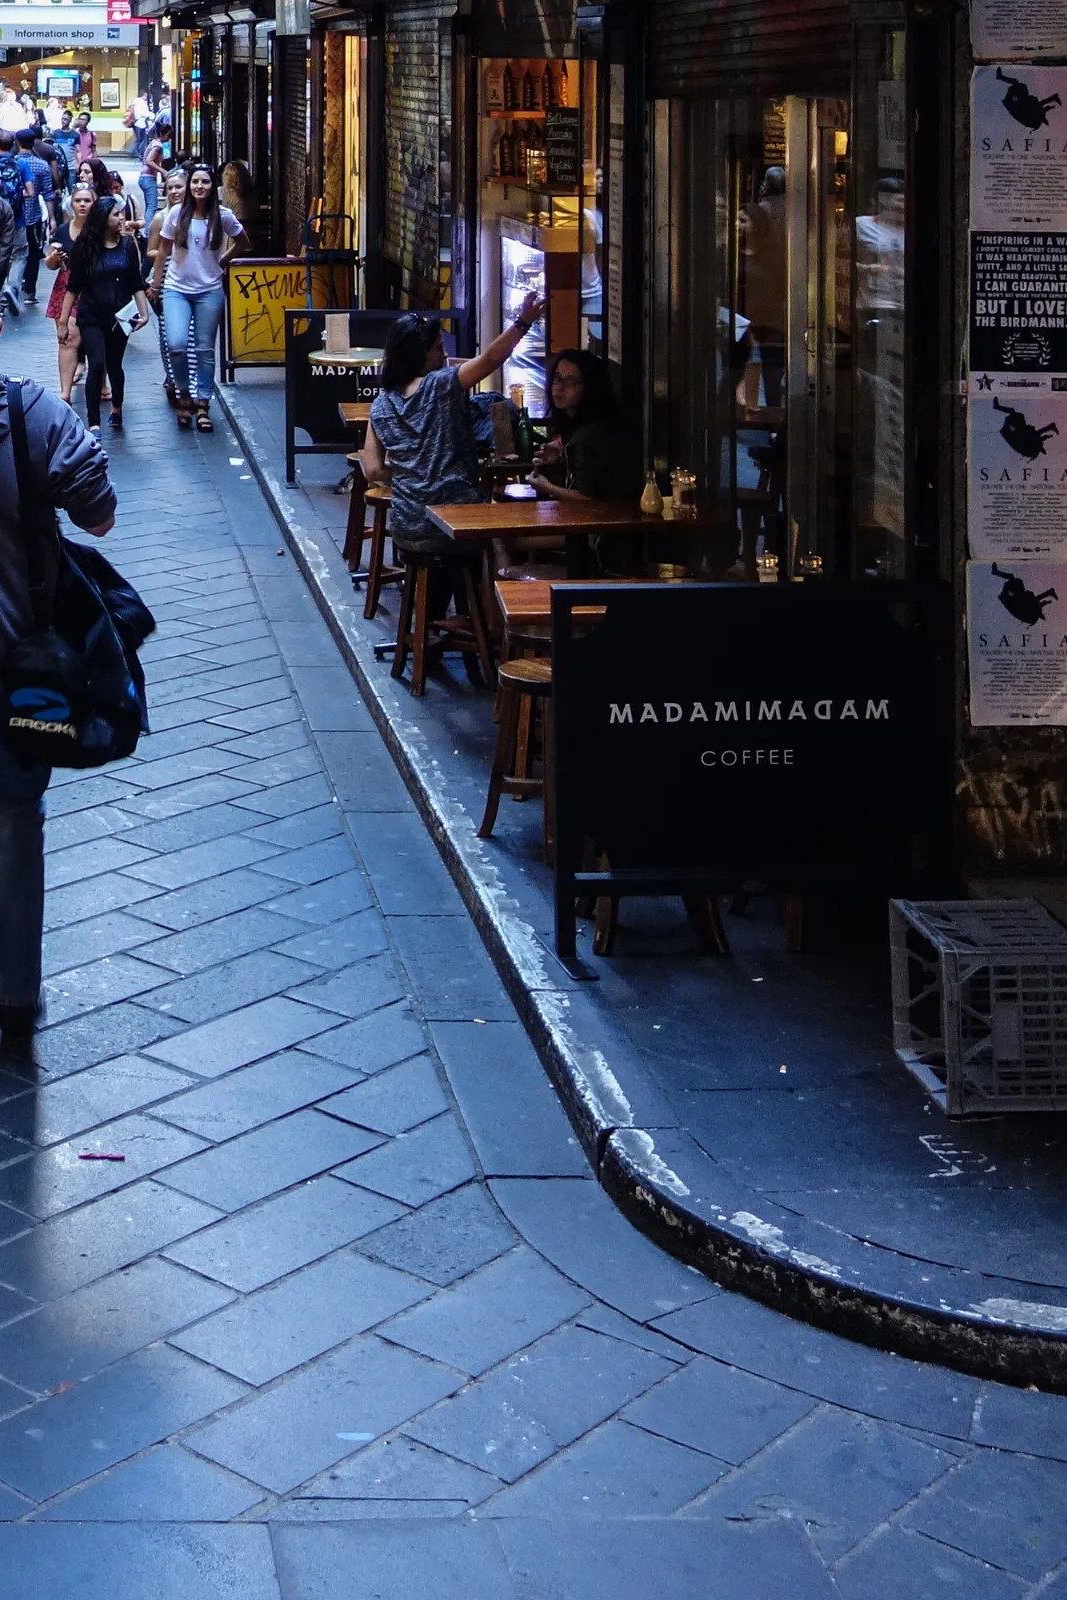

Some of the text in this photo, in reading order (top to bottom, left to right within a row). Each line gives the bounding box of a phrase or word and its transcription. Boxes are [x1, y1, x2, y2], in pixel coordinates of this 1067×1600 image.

[14, 29, 69, 38] Information
[71, 29, 95, 41] shop
[1033, 236, 1044, 245] IN
[1046, 236, 1053, 245] A
[976, 253, 983, 261] IT
[986, 253, 1005, 261] WAS
[976, 263, 1003, 272] WITTY,
[1006, 263, 1023, 271] AND
[1025, 263, 1031, 271] A
[1033, 263, 1056, 272] LITTLE
[975, 272, 984, 280] IN
[986, 272, 991, 280] A
[1021, 273, 1057, 281] BEAUTIFUL
[976, 281, 1067, 293] I CAN GUARANT
[976, 299, 1067, 316] BUT I LOVE
[974, 316, 997, 327] THE
[609, 699, 890, 724] MADAMIMADAM
[700, 749, 795, 767] COFFEE
